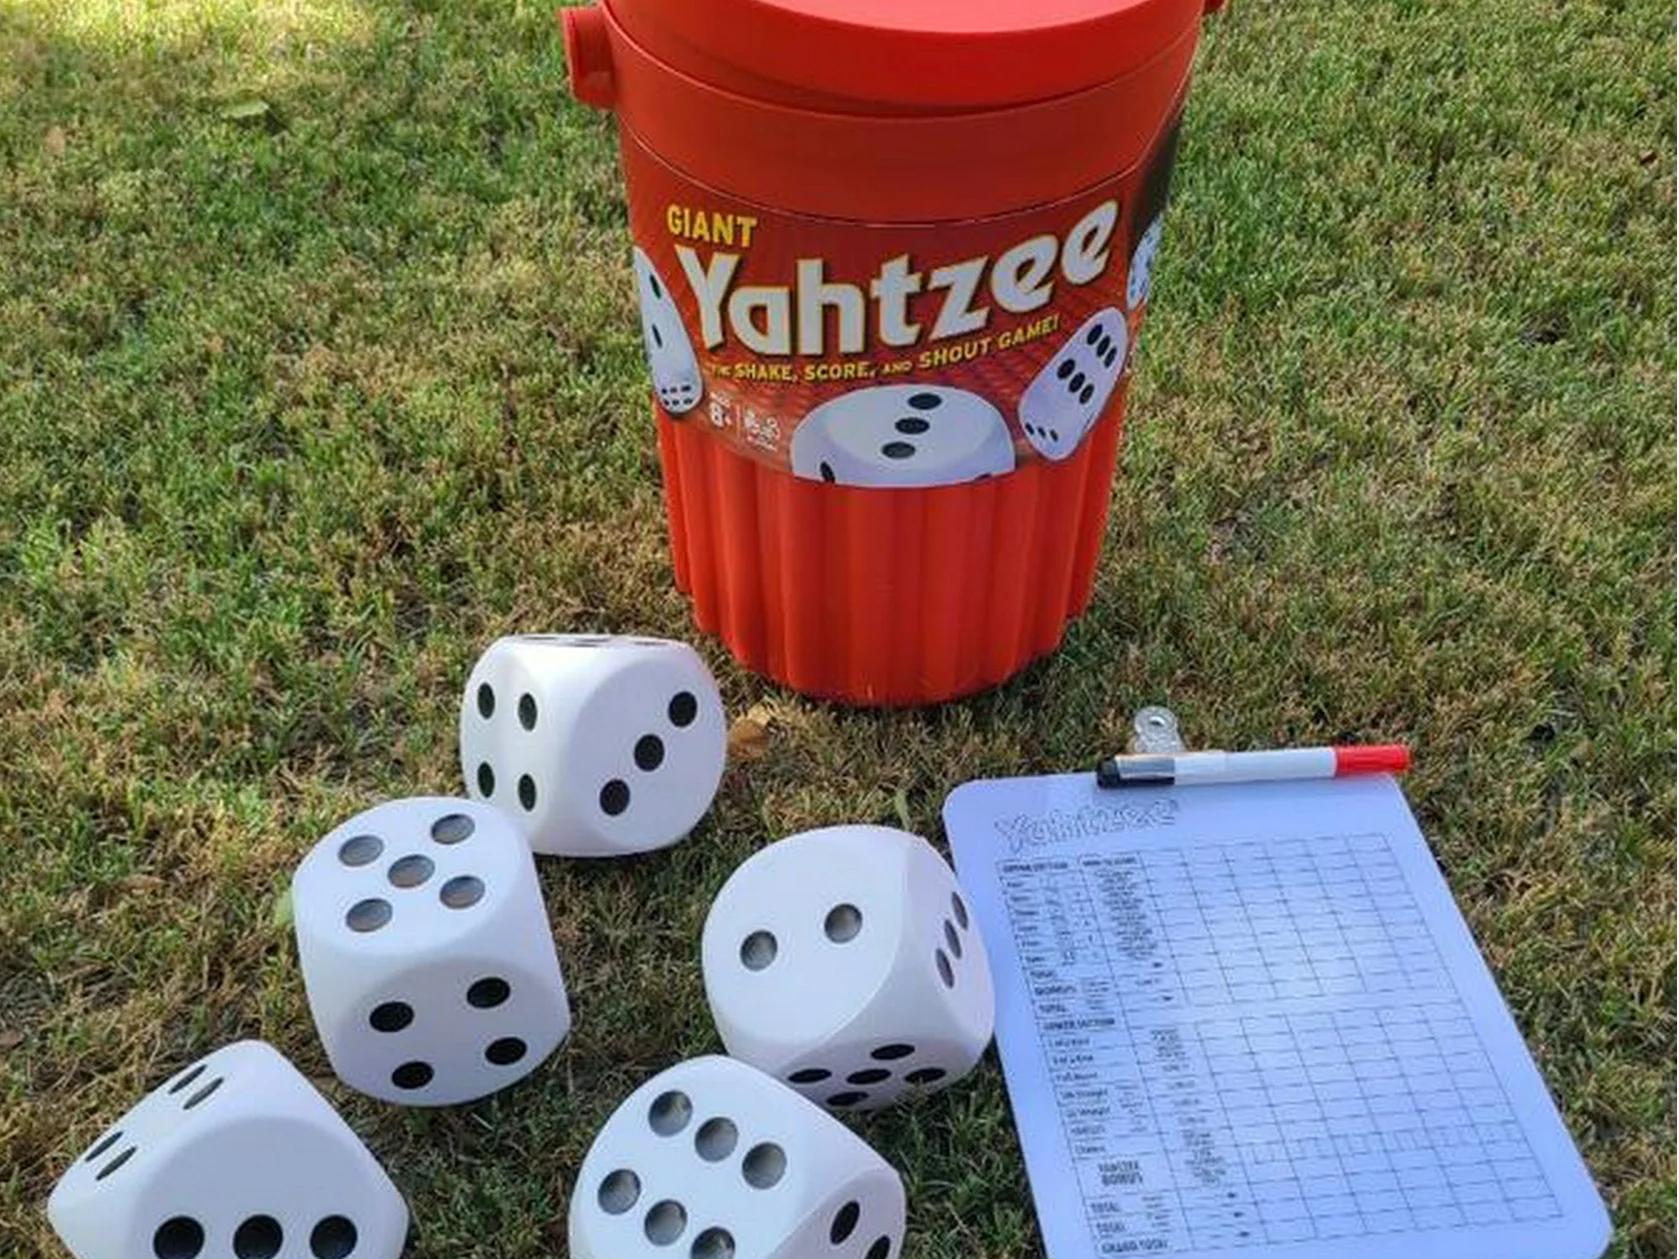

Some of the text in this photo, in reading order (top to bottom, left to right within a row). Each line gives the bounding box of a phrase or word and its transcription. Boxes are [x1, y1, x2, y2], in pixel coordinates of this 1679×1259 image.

[667, 204, 757, 247] GIANT
[674, 200, 1119, 355] Yahtzee
[733, 363, 797, 382] SHAKE,
[804, 361, 875, 380] SCORE,
[882, 361, 913, 375] AND
[918, 336, 991, 369] SHOUT
[998, 313, 1060, 349] GAME!
